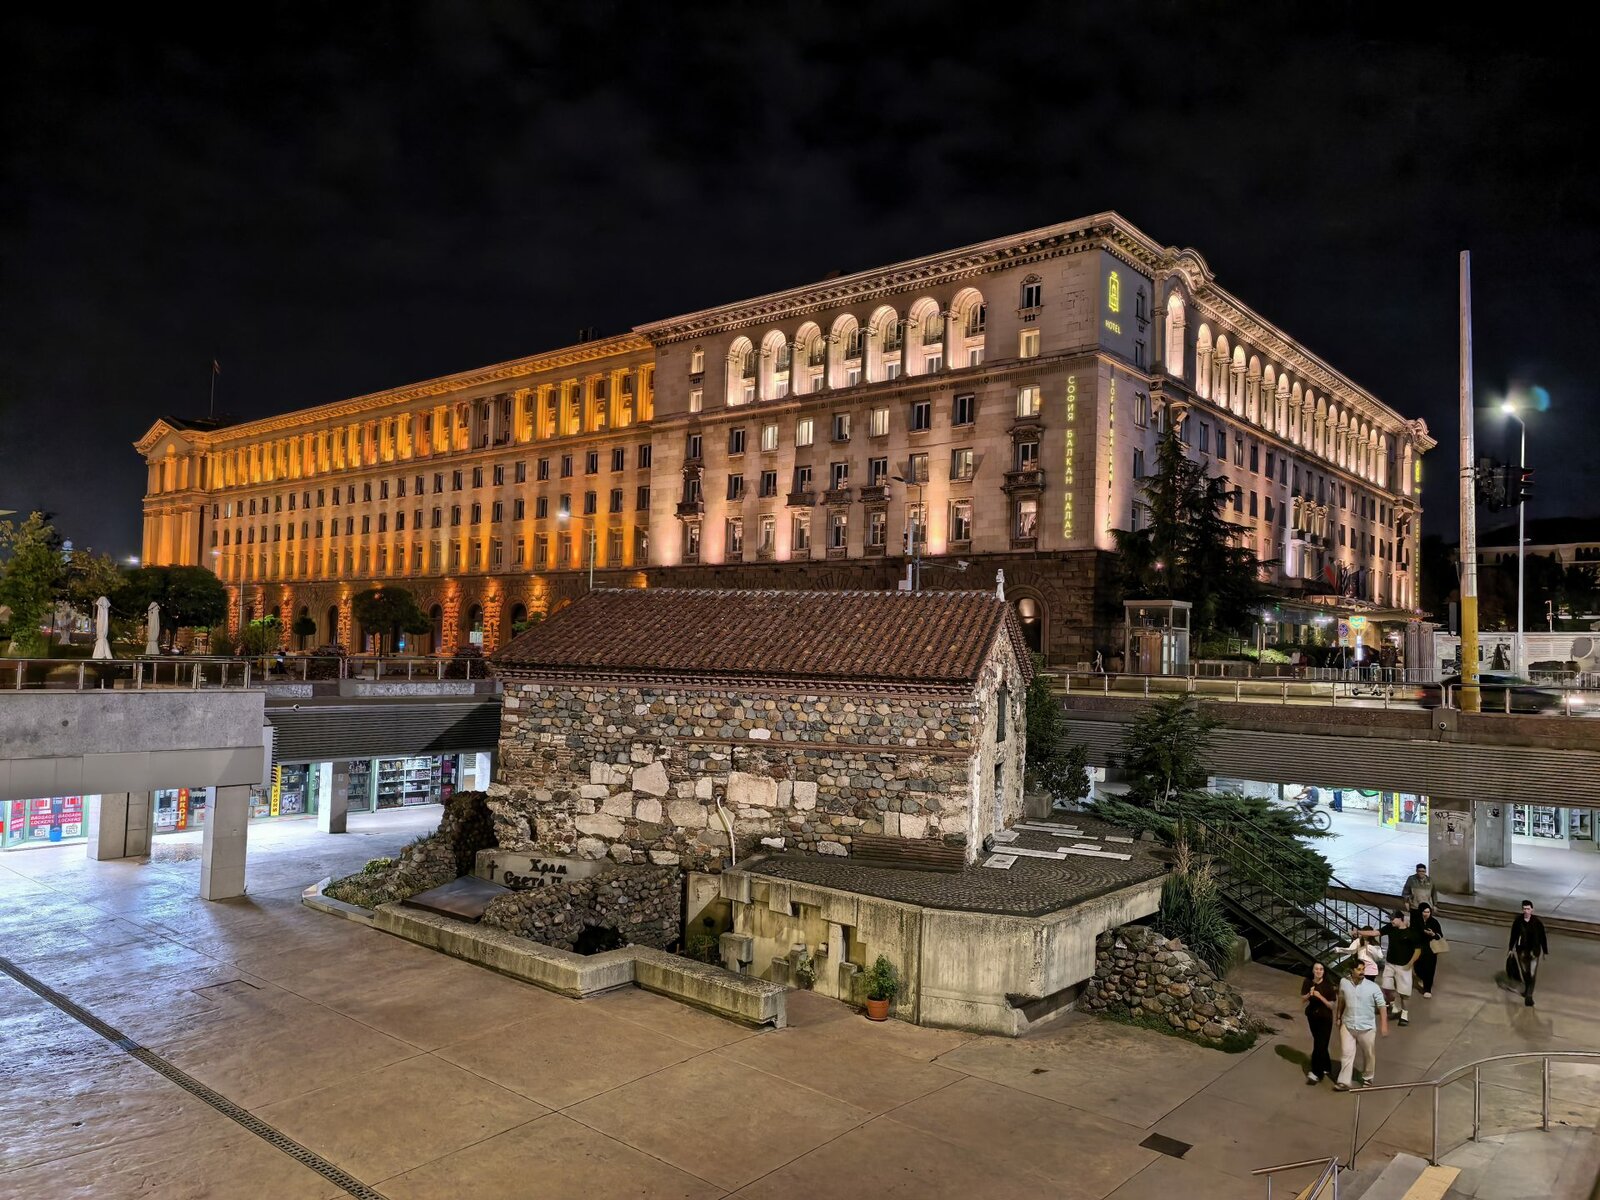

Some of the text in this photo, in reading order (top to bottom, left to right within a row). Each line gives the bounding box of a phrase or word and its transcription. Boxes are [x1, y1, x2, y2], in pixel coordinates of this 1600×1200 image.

[1105, 319, 1121, 335] HOTEL
[1064, 375, 1075, 539] СОФИЯ БАЛКАН ПАЛАС
